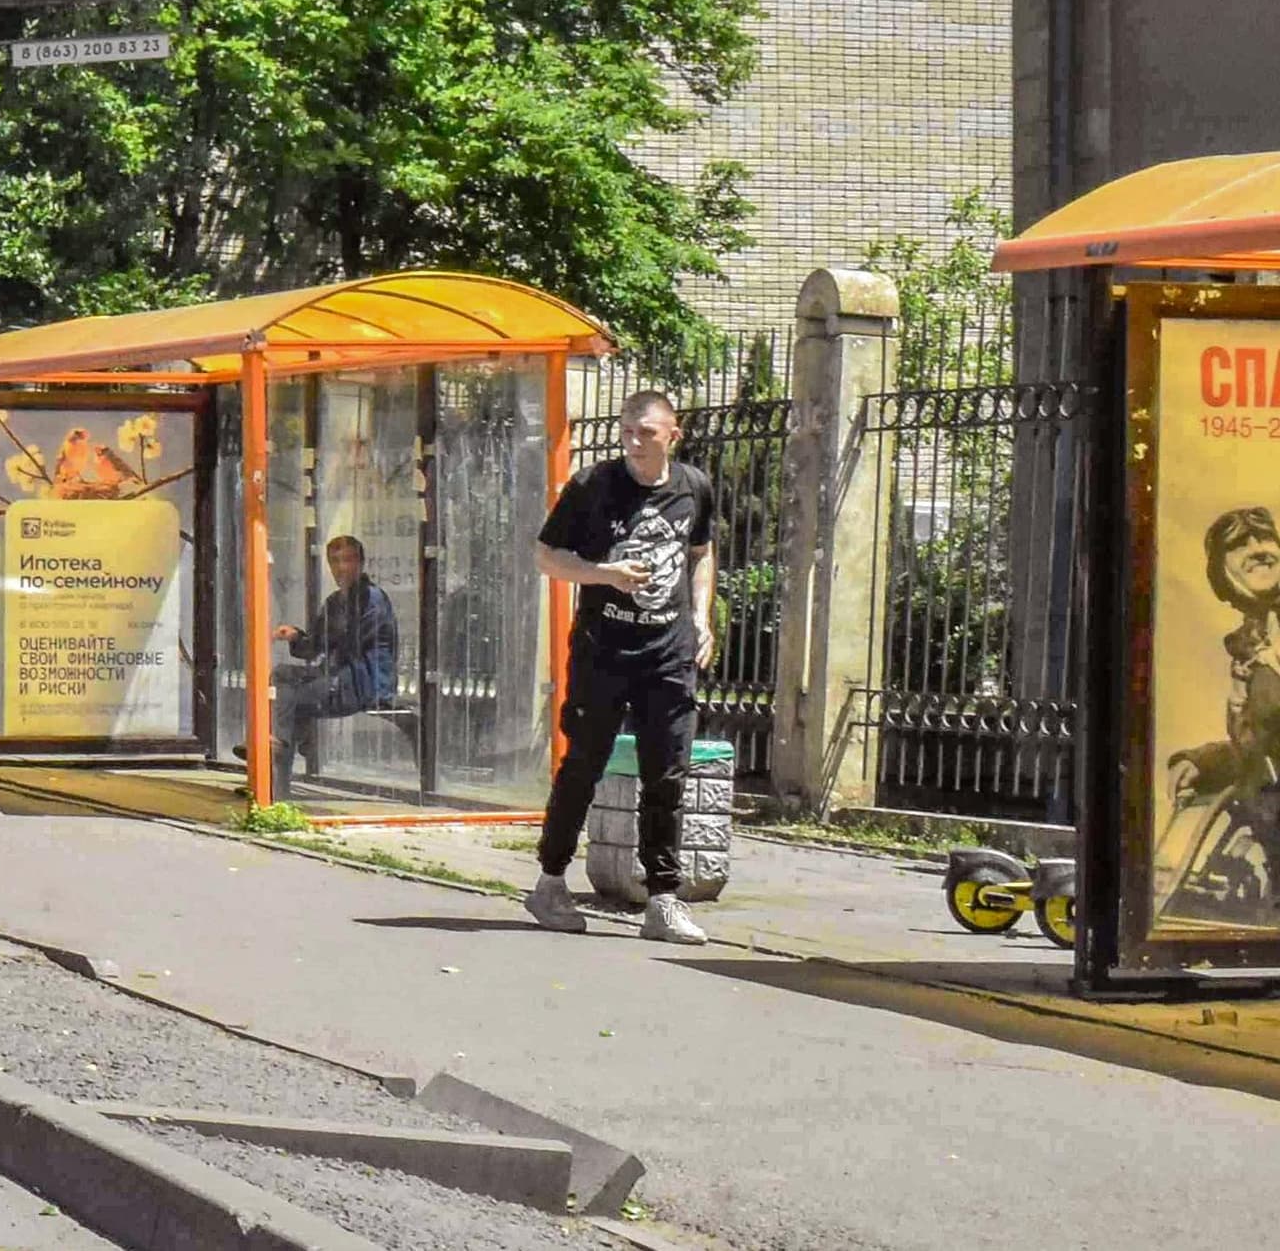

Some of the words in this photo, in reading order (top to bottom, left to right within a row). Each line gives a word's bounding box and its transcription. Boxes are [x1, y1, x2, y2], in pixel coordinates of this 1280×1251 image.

[36, 43, 78, 61] (863)
[83, 42, 113, 56] 200
[118, 40, 136, 54] 83
[142, 38, 160, 53] 23
[20, 554, 102, 571] Ипотека
[20, 572, 164, 594] по-семейному
[19, 634, 116, 651] ОЦЕНИВАЙТЕ
[19, 652, 58, 666] СВОИ
[67, 652, 165, 666] ФИНАНСОВЫЕ
[19, 667, 125, 681] ВОЗМОЖНОСТИ
[19, 682, 28, 695] И
[38, 682, 86, 695] РИСКИ
